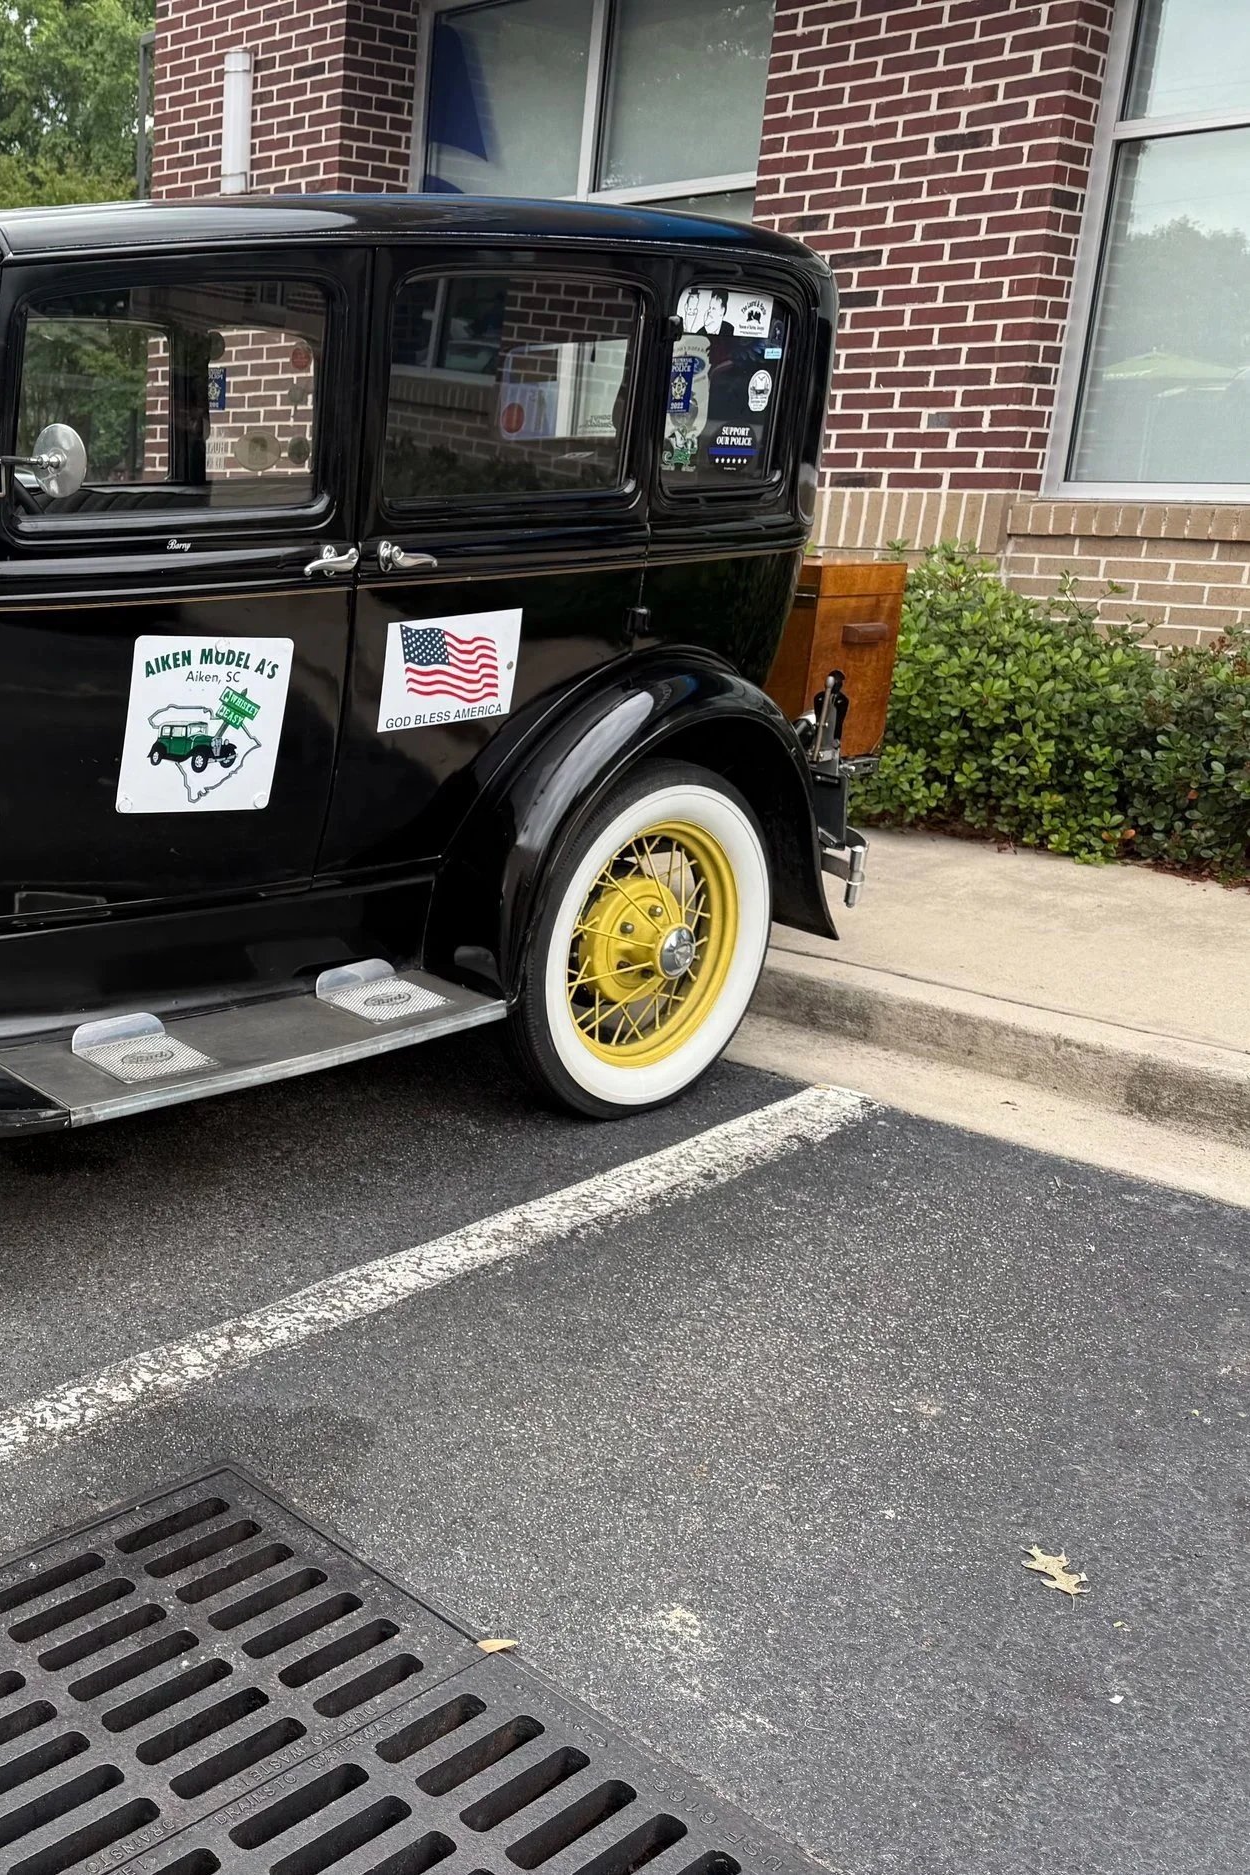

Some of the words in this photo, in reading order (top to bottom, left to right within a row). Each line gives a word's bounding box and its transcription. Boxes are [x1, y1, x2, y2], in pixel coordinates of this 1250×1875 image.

[671, 365, 691, 373] POLICE
[716, 436, 730, 445] OUR
[730, 437, 753, 446] POLICE
[722, 426, 750, 436] SUPPORT
[145, 650, 192, 678] AIKEN
[200, 648, 251, 670] MODEL
[254, 658, 279, 680] A'S
[185, 671, 222, 685] Aiken,
[226, 671, 241, 683] SC
[229, 692, 259, 717] WHISKEY
[223, 707, 243, 726] EASY
[385, 716, 411, 729] GOD
[414, 711, 451, 726] BLESS
[453, 703, 502, 720] AMERICA
[336, 1705, 377, 1733] DUMP
[310, 1729, 335, 1746] NO
[214, 1787, 276, 1826] DRAINS
[274, 1773, 298, 1790] TO
[307, 1712, 404, 1770] WATERWAYS
[110, 1818, 175, 1859] DRAINS
[85, 1853, 113, 1873] TO
